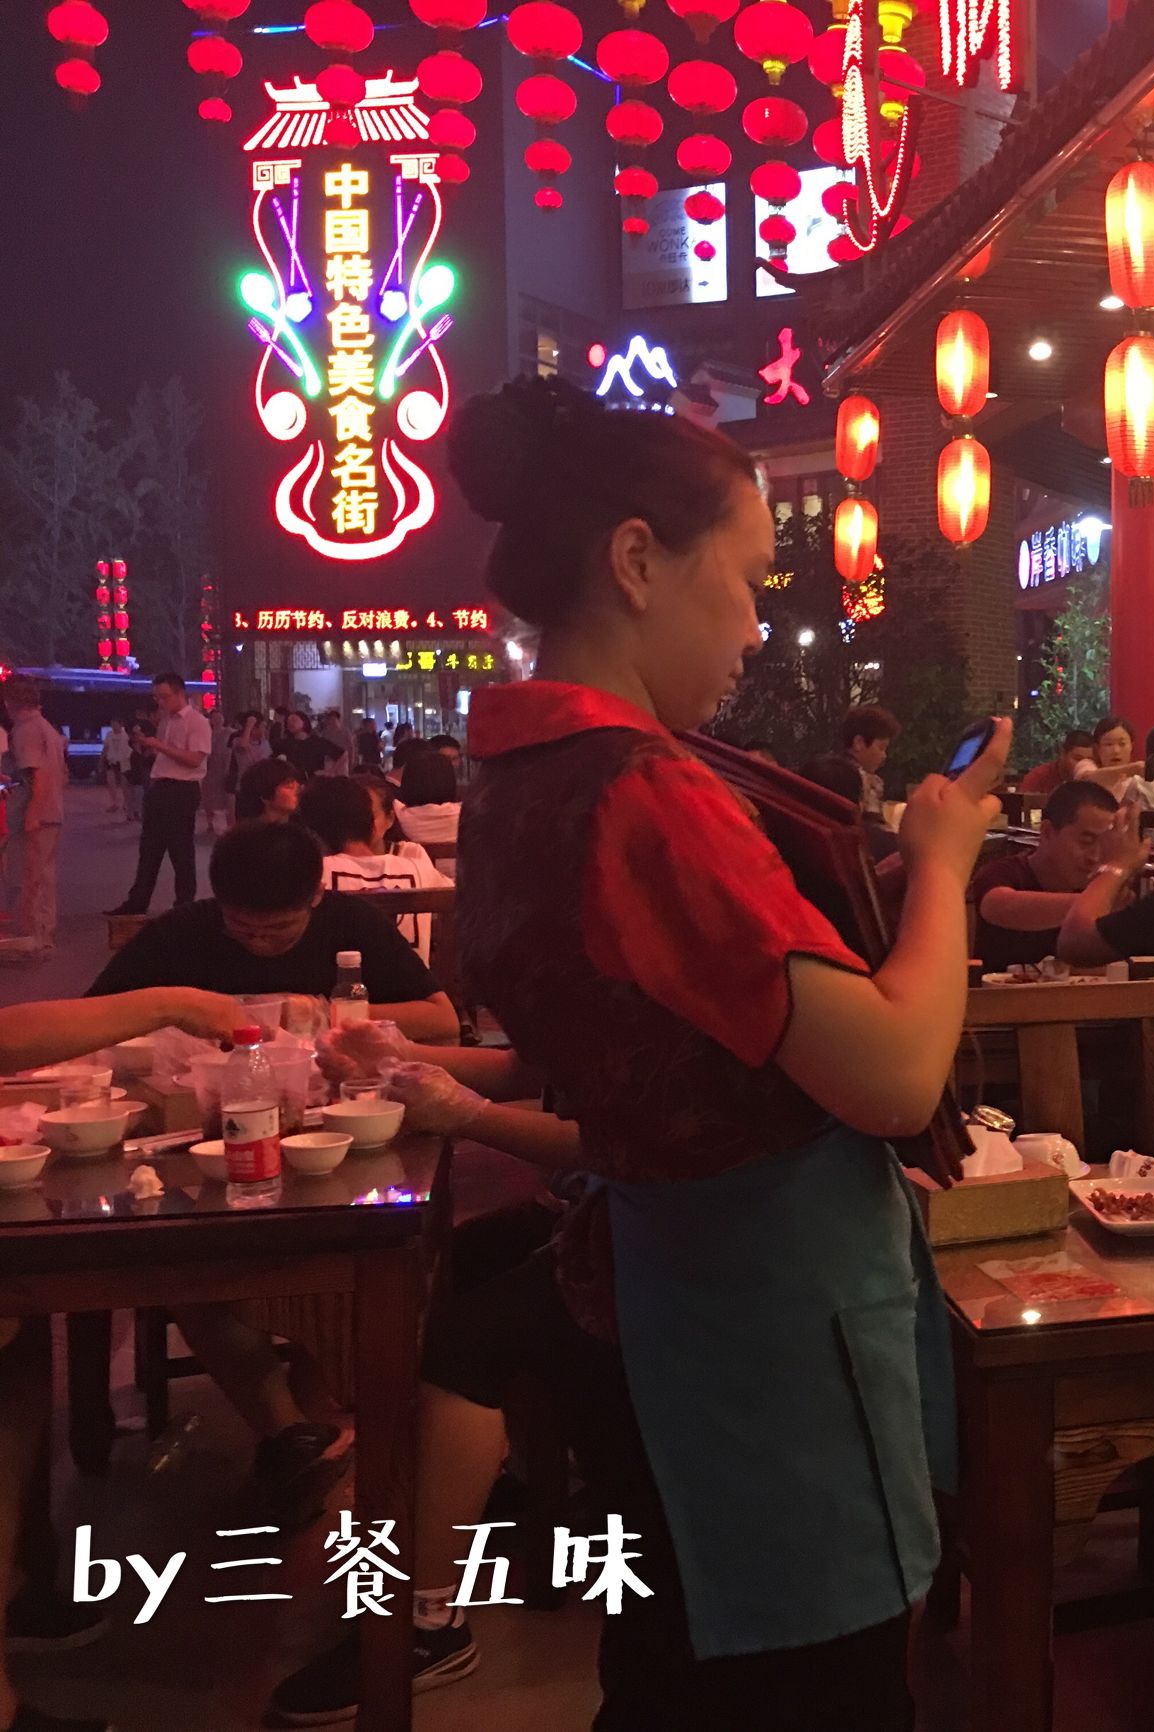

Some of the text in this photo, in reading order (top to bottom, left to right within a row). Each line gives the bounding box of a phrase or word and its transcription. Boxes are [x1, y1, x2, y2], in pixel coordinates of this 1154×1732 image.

[325, 163, 379, 534] 中国特色美食名街
